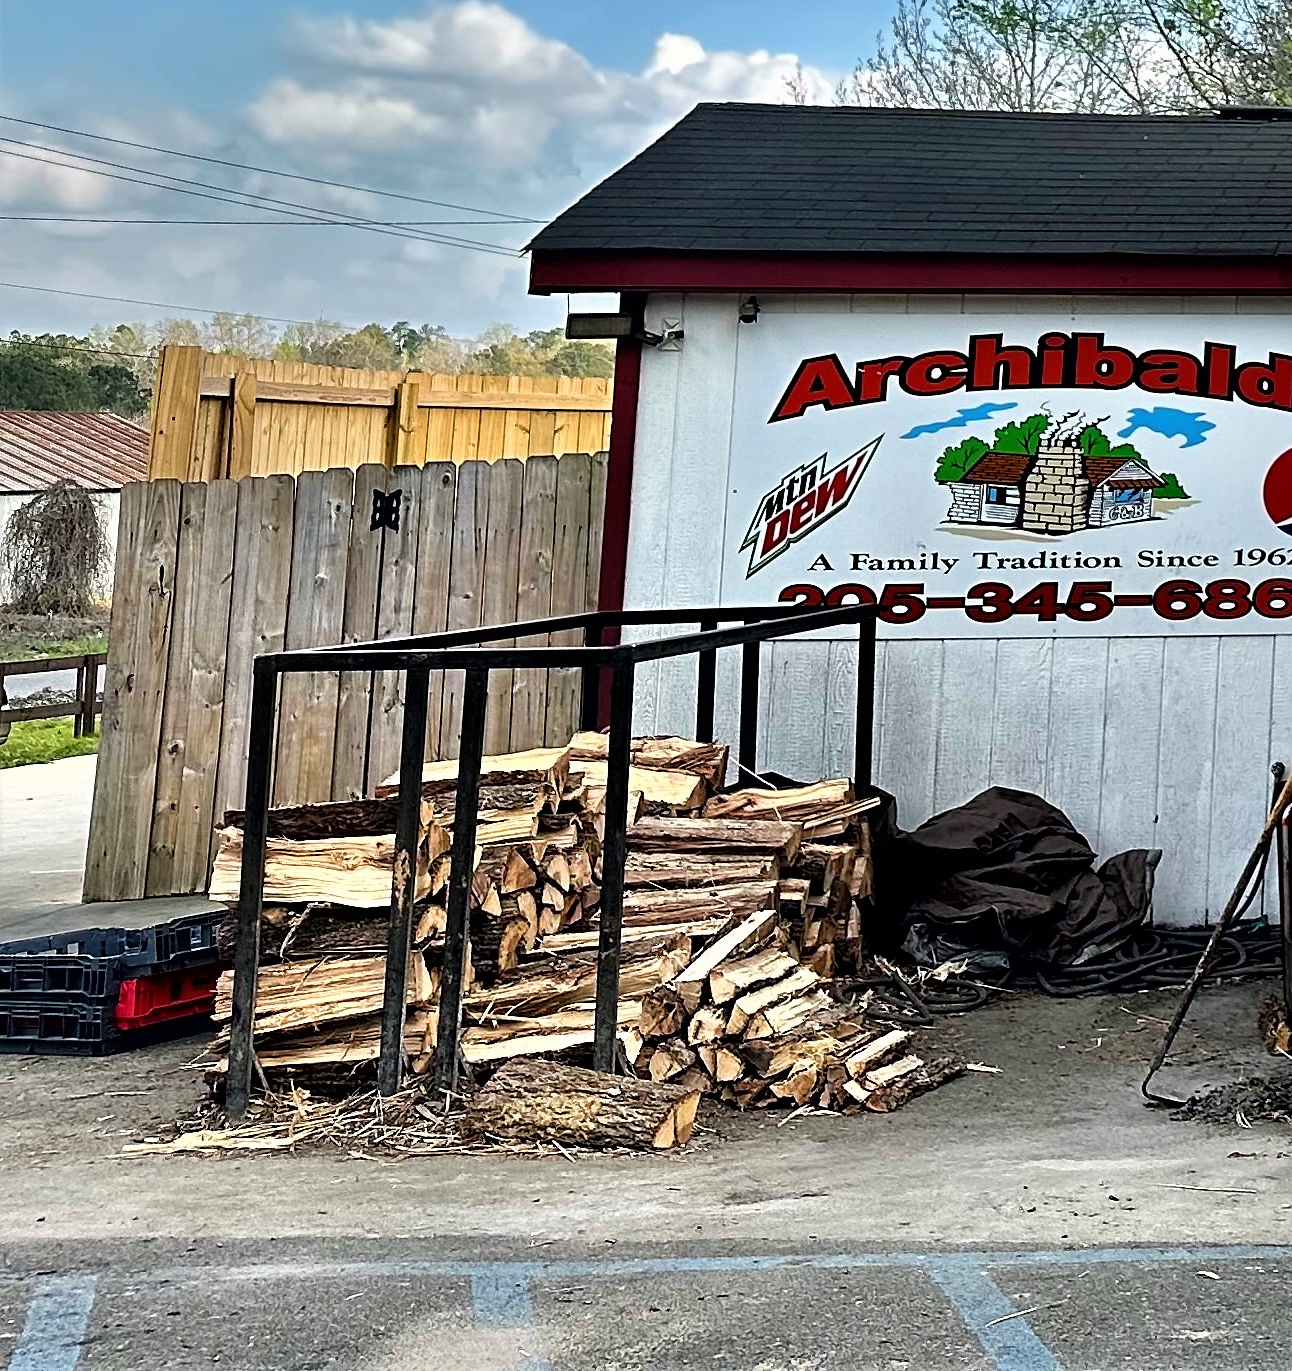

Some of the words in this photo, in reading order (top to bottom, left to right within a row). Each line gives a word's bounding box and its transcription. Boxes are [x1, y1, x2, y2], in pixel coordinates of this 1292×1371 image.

[754, 465, 818, 530] Mtn
[760, 451, 868, 559] Dew
[807, 554, 835, 571] A
[850, 552, 959, 574] Family
[973, 550, 1122, 570] Tradition
[1137, 550, 1219, 568] Since
